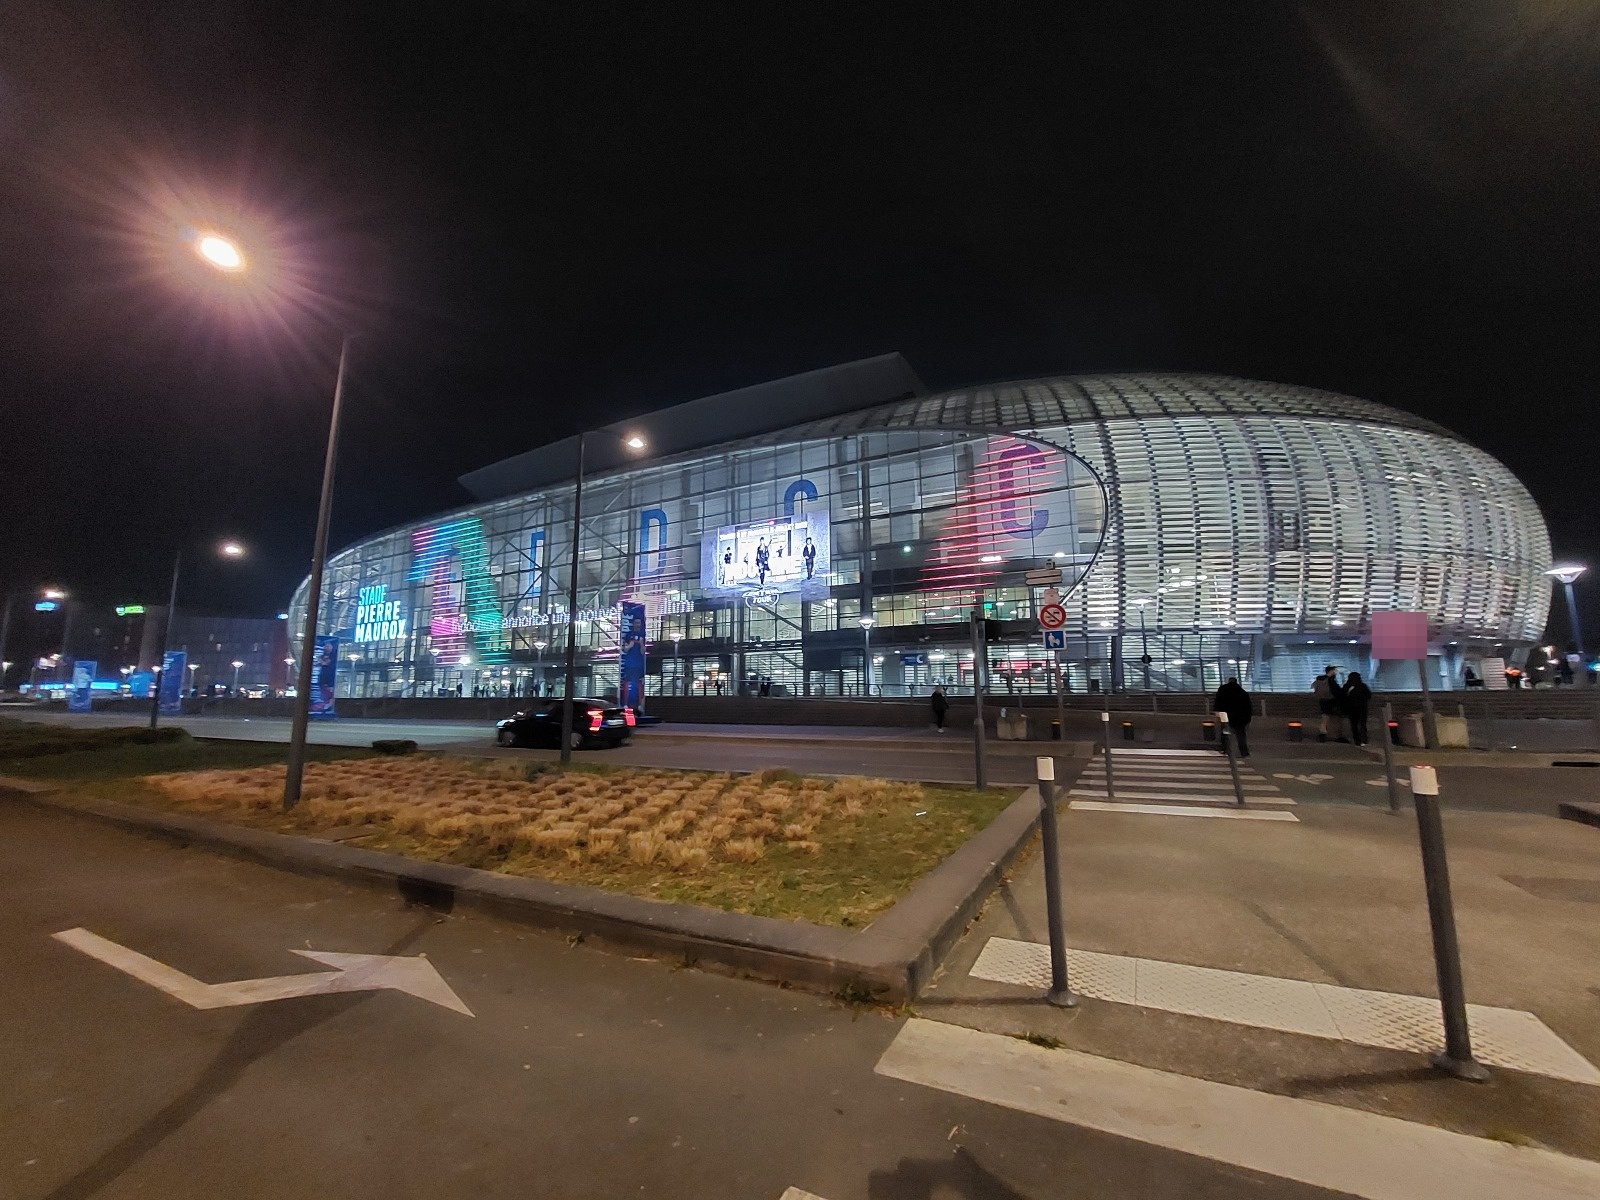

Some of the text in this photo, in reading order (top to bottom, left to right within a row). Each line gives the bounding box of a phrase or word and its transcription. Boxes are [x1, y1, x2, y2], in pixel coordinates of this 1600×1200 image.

[998, 444, 1049, 539] C
[359, 584, 388, 605] STADE
[357, 600, 401, 624] PIERRE
[501, 613, 549, 629] annonce
[354, 618, 407, 643] MAUROY
